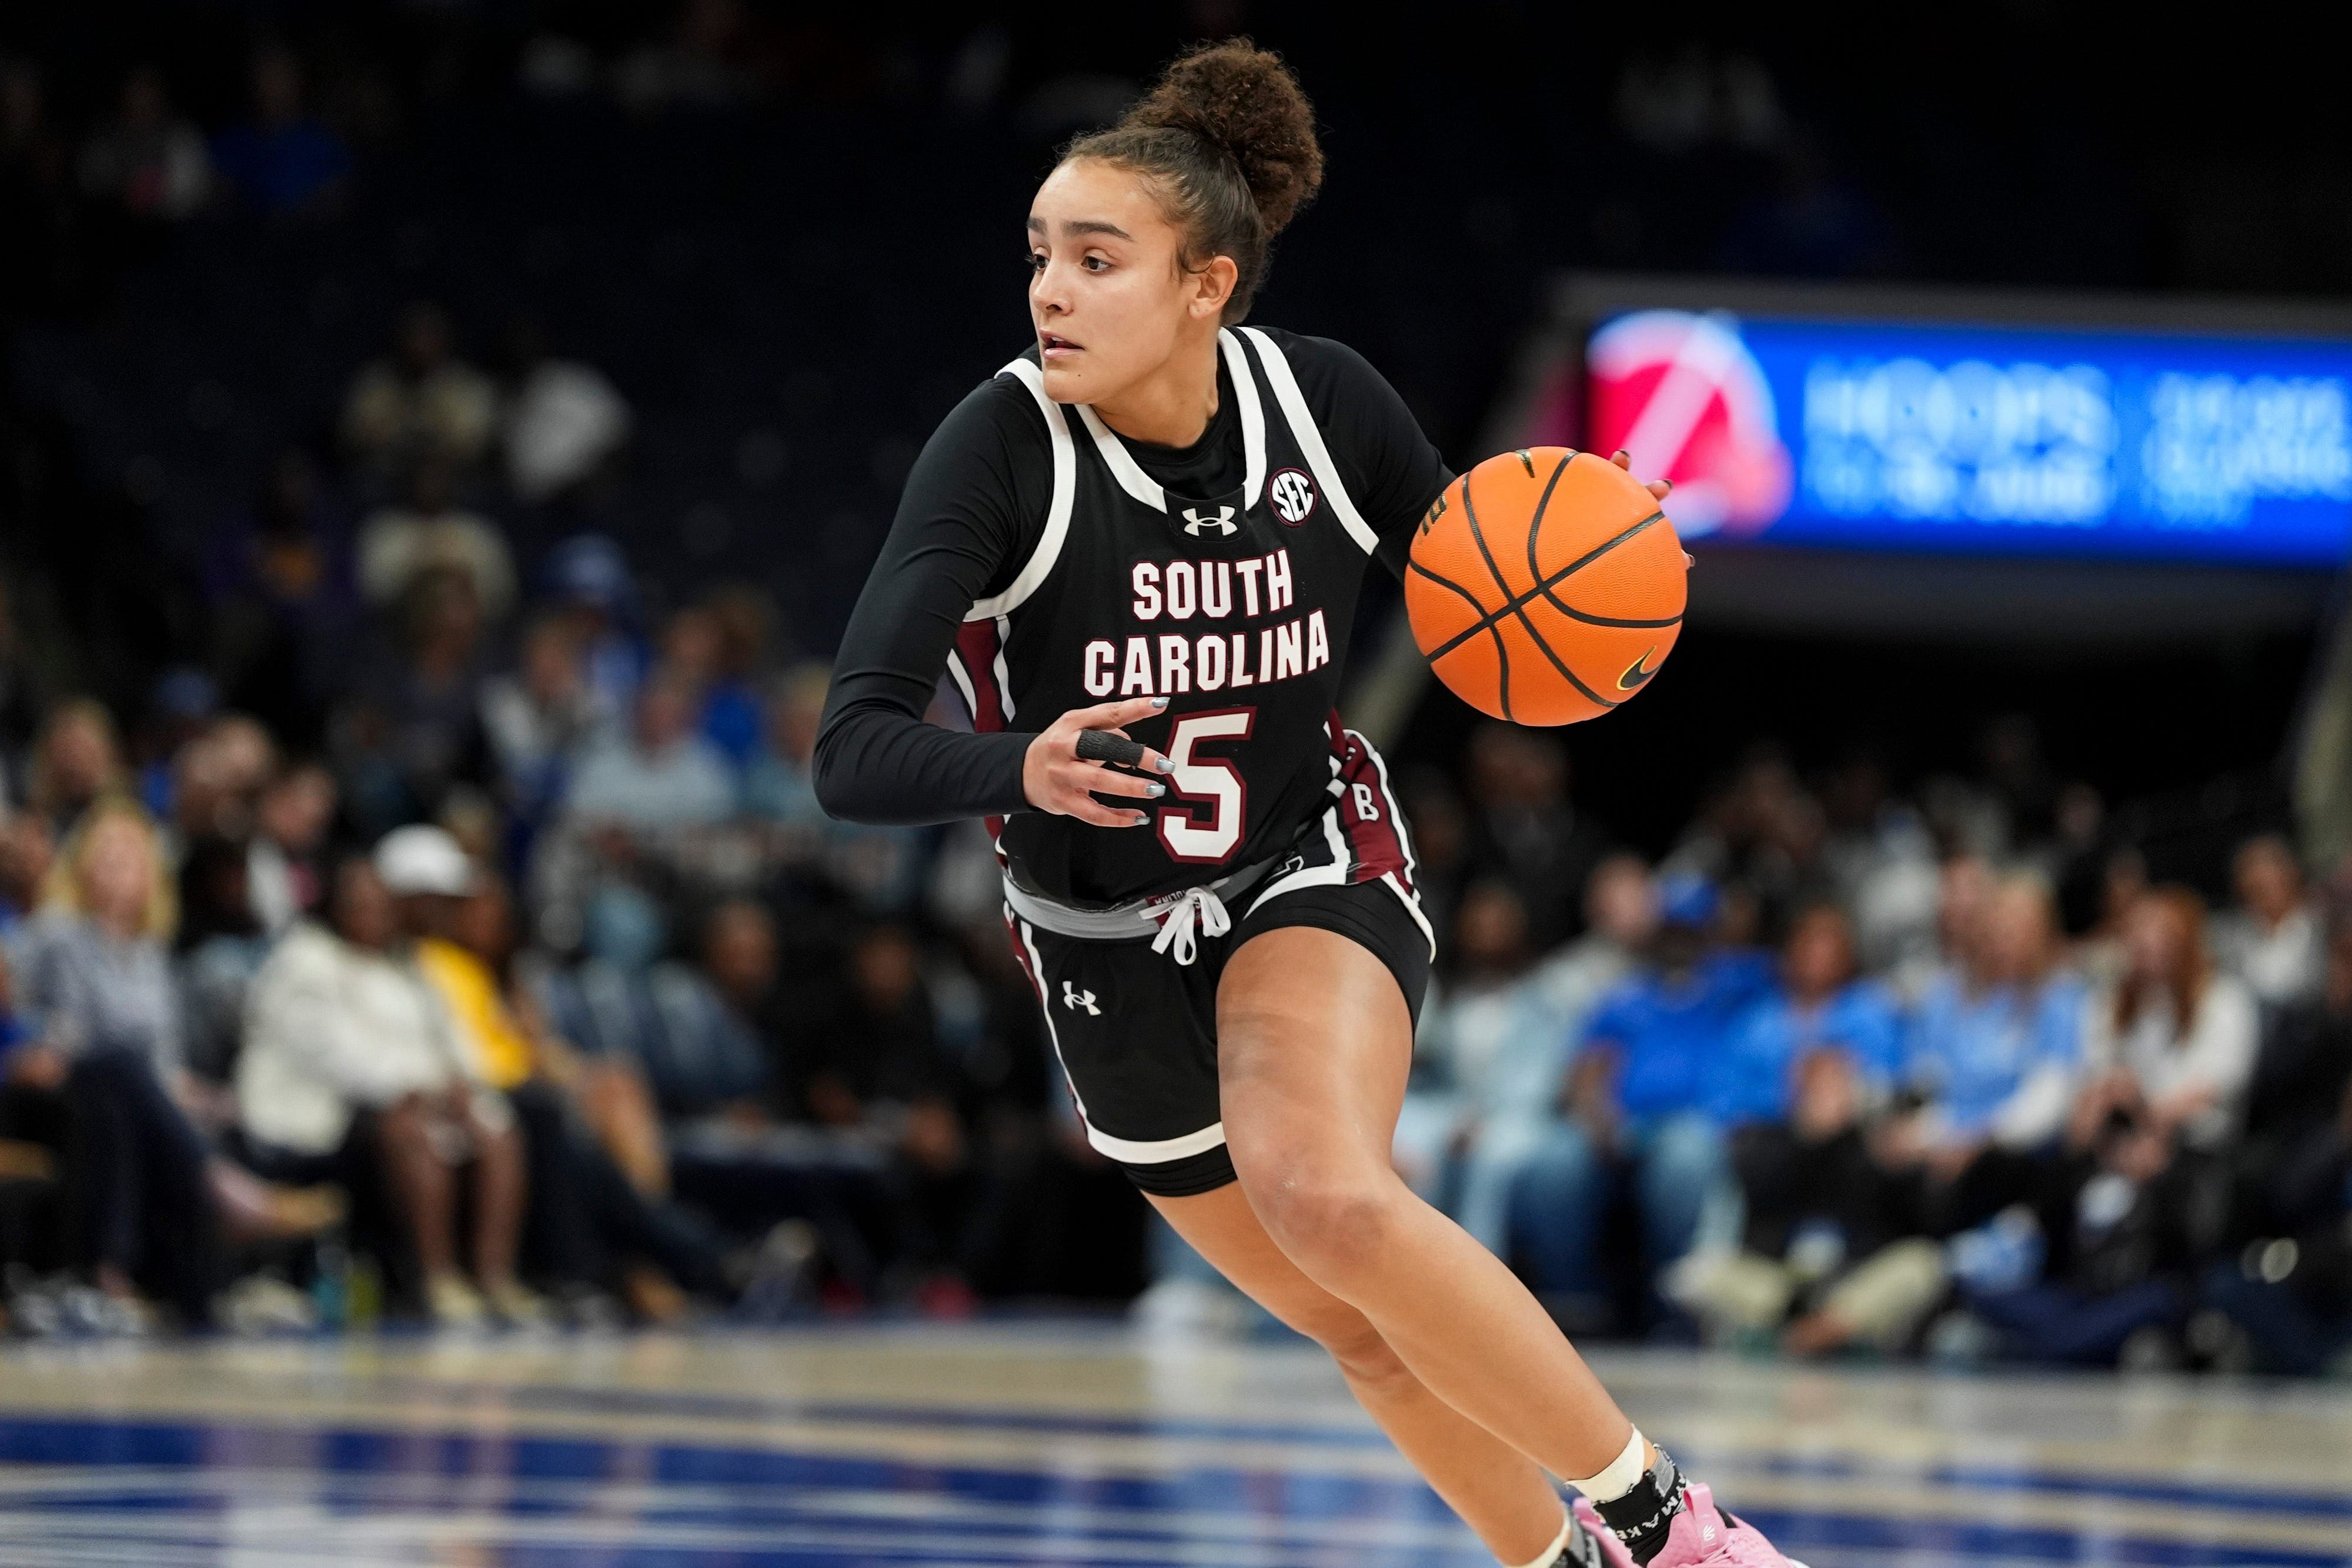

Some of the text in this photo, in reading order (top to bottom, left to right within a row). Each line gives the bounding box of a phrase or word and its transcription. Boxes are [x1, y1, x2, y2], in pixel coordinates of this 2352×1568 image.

[1271, 471, 1314, 523] SEC
[1131, 547, 1294, 621] SOUTH
[1083, 607, 1330, 697] CAROLINA
[1157, 706, 1258, 865] 5
